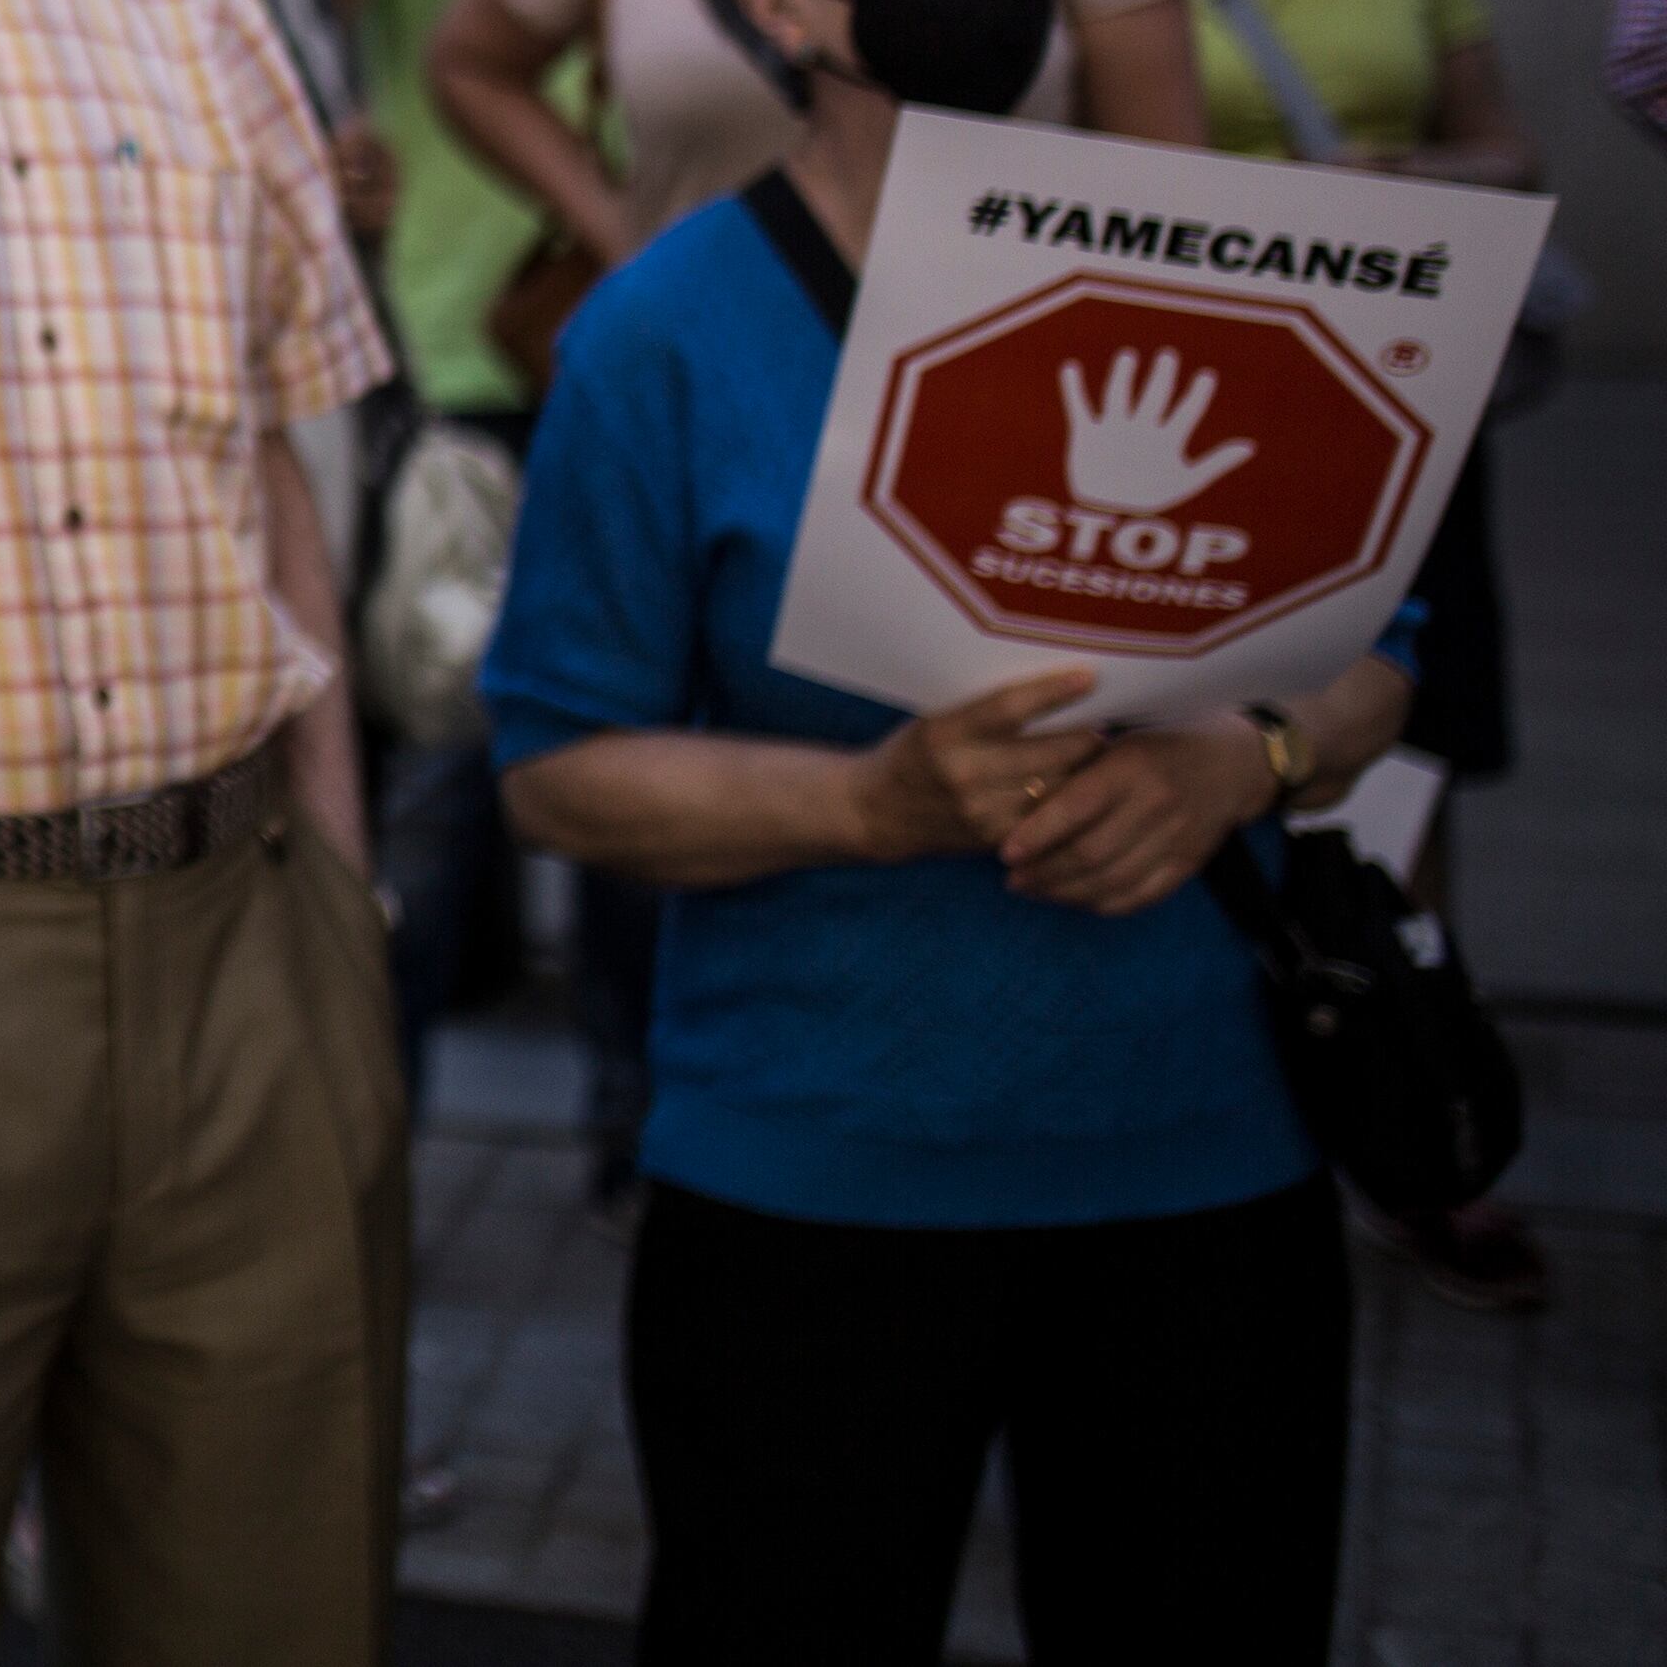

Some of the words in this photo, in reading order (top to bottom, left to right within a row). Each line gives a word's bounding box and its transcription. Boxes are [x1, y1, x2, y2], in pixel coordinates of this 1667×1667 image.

[968, 189, 1450, 298] #YAMECANSÉ
[996, 497, 1249, 576] STOP
[971, 547, 1248, 610] SUCESIONES
